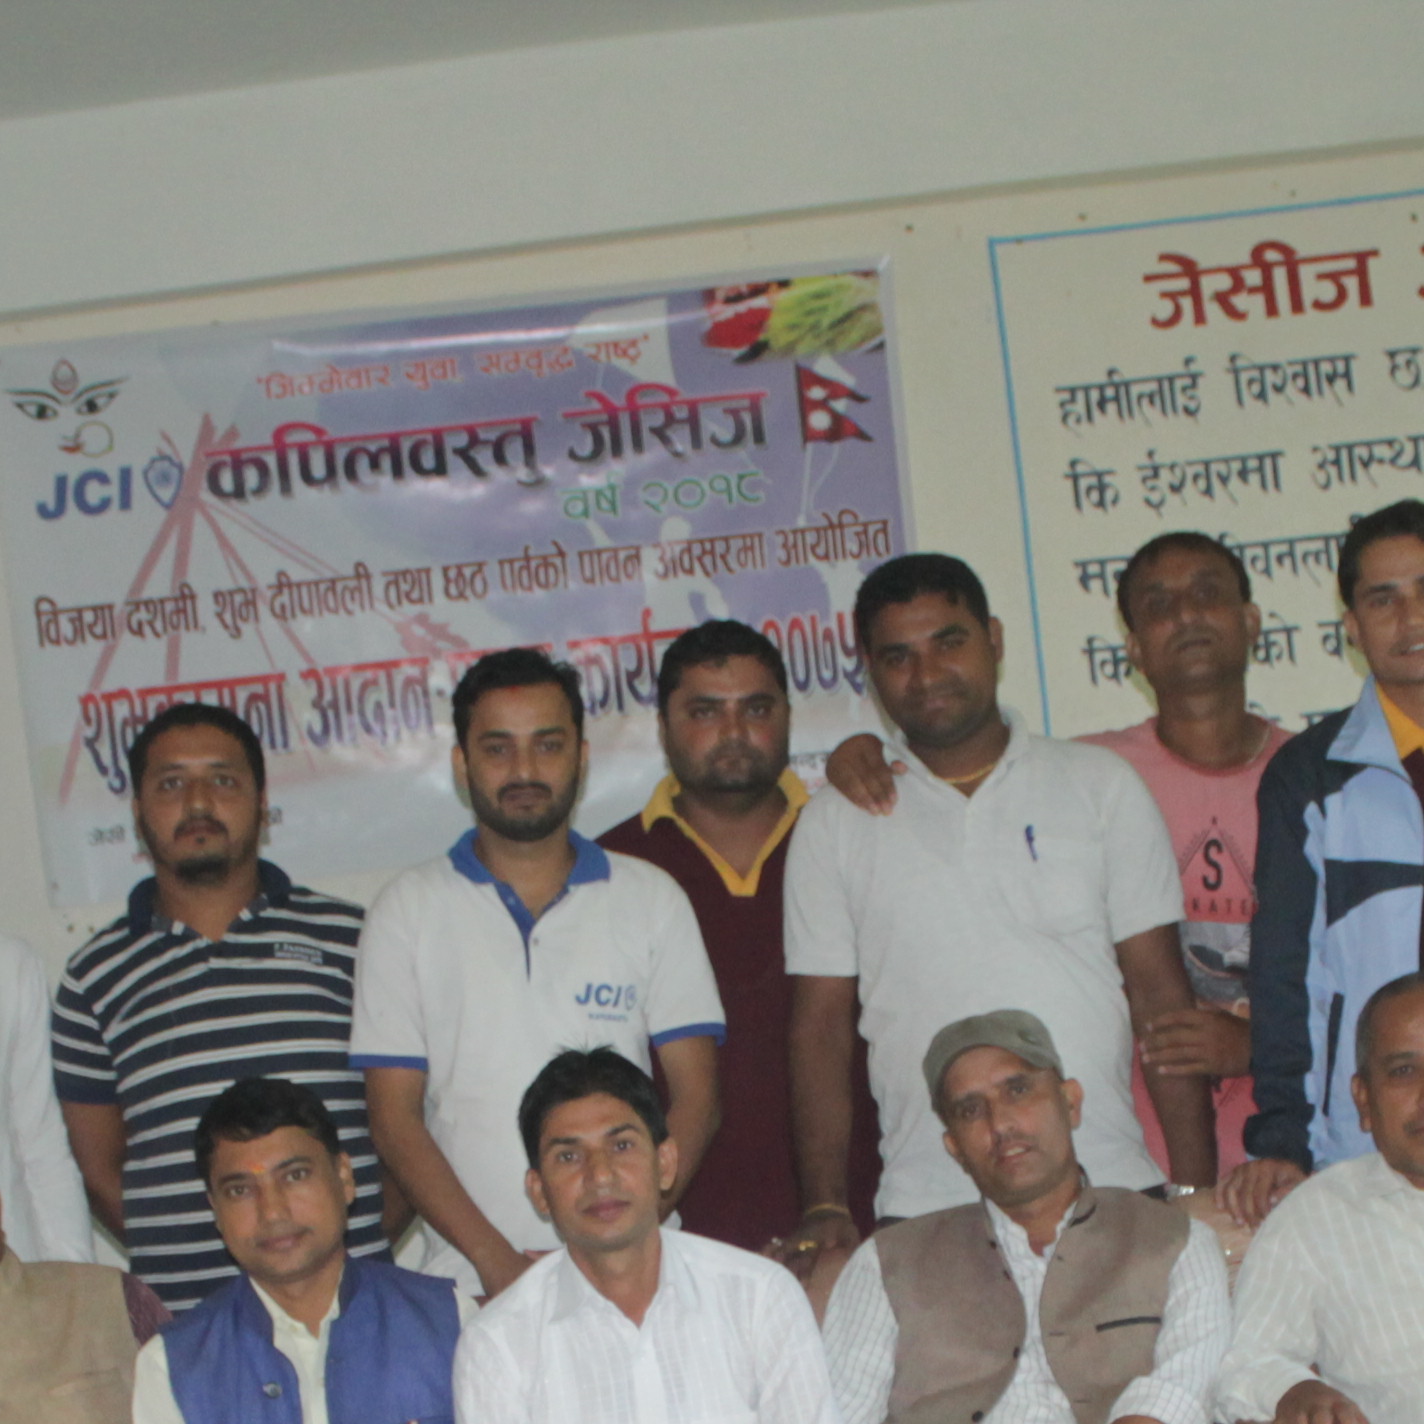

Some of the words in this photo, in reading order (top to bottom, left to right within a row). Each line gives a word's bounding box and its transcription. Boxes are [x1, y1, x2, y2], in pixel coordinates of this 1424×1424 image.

[1142, 240, 1380, 330] जेसीज
[1055, 355, 1204, 435] हामीलाई
[1227, 352, 1358, 409] विश्वास
[205, 416, 541, 500] कपिलवस्तु
[562, 382, 770, 462] जेसिज
[36, 465, 132, 521] JCI
[560, 472, 622, 520] वर्ष
[640, 470, 766, 513] २०१८
[1065, 457, 1120, 514] कि
[1136, 447, 1286, 517] ईश्वरमा
[34, 594, 118, 649] विजया
[213, 586, 261, 641] शुभ
[270, 561, 375, 624] दीपावली
[382, 566, 435, 611] तथा
[442, 560, 489, 602] छठ
[498, 540, 570, 595] पर्वको
[577, 545, 643, 586] पावन
[653, 531, 766, 581] अवसरमा
[776, 509, 893, 568] आयोजित
[761, 610, 866, 697] ०७५
[1202, 838, 1224, 891] S
[574, 982, 623, 1008] JCI
